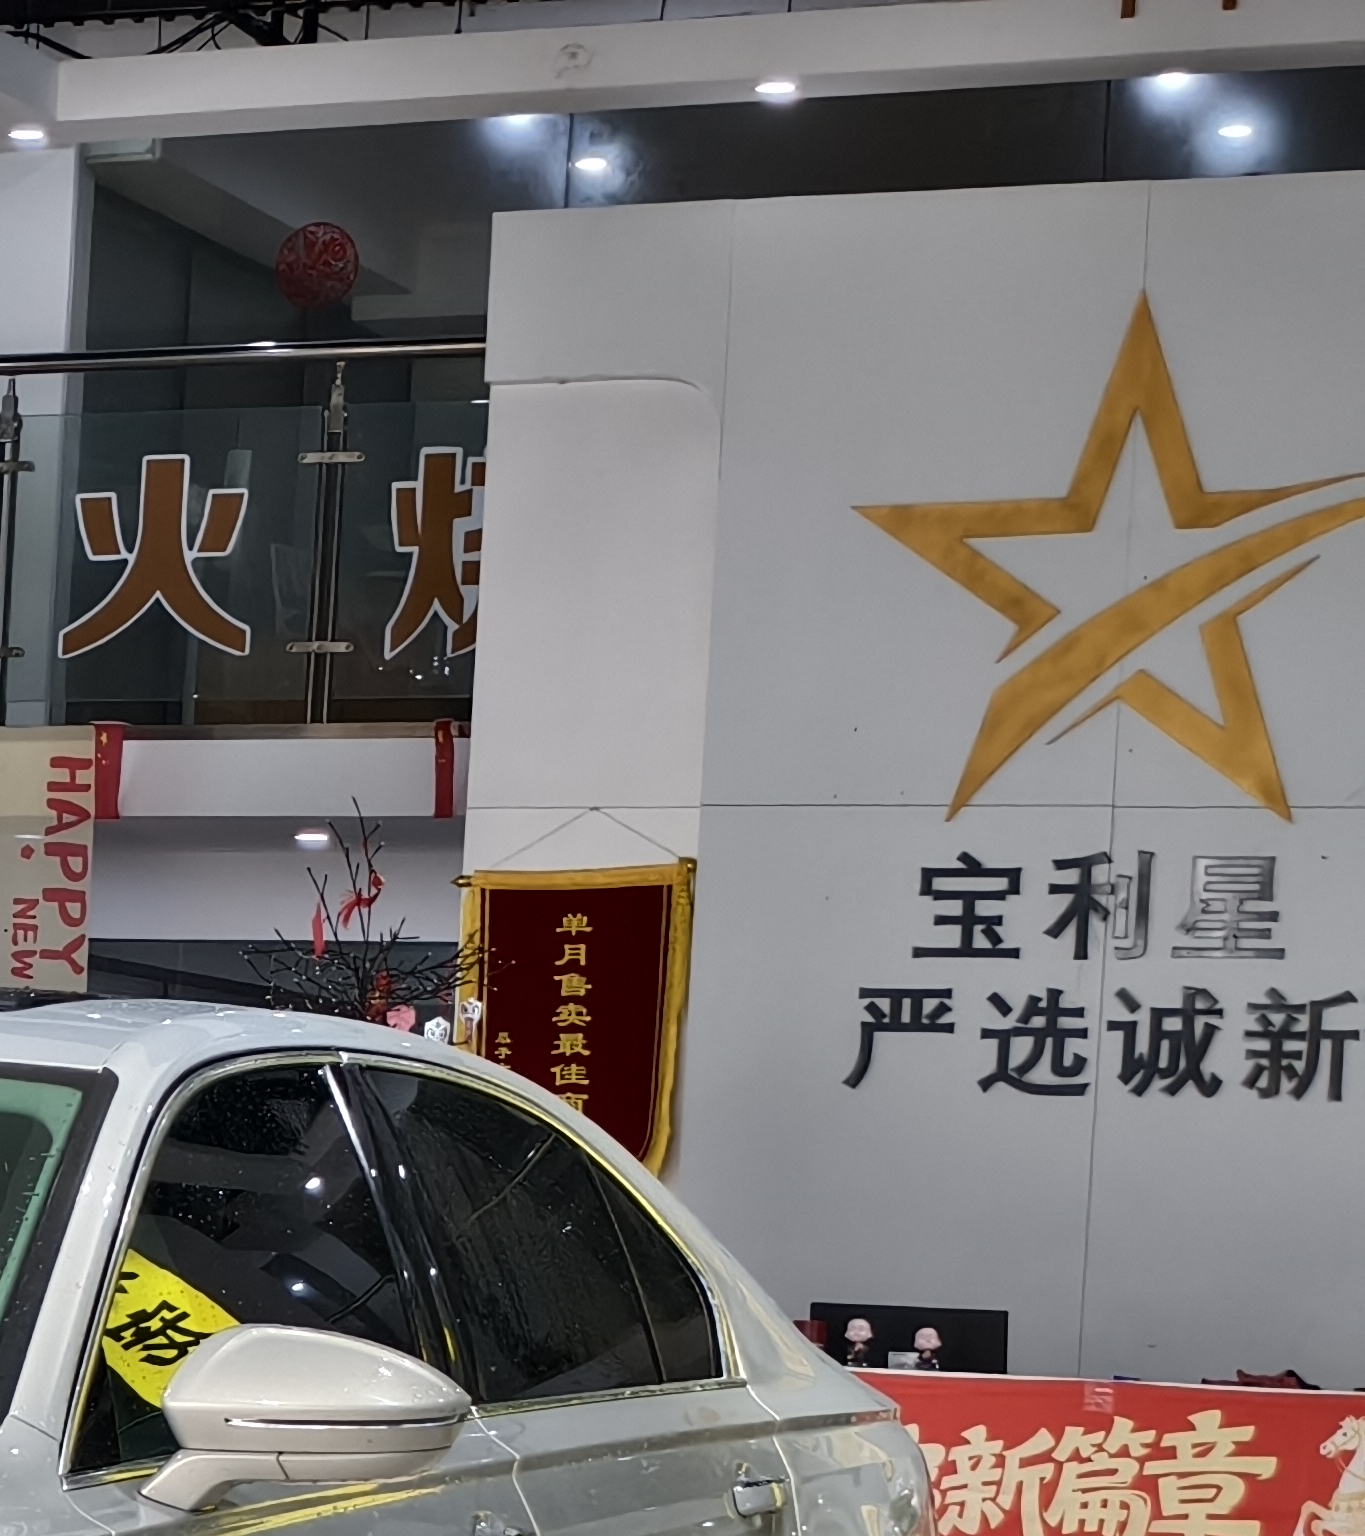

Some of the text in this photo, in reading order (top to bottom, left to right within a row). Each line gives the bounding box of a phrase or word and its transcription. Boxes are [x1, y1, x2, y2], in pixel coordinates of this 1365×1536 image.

[38, 756, 93, 976] HAPPY
[912, 851, 1286, 960] 宝利星
[10, 898, 40, 980] NEW
[842, 986, 1361, 1102] 严选诚新
